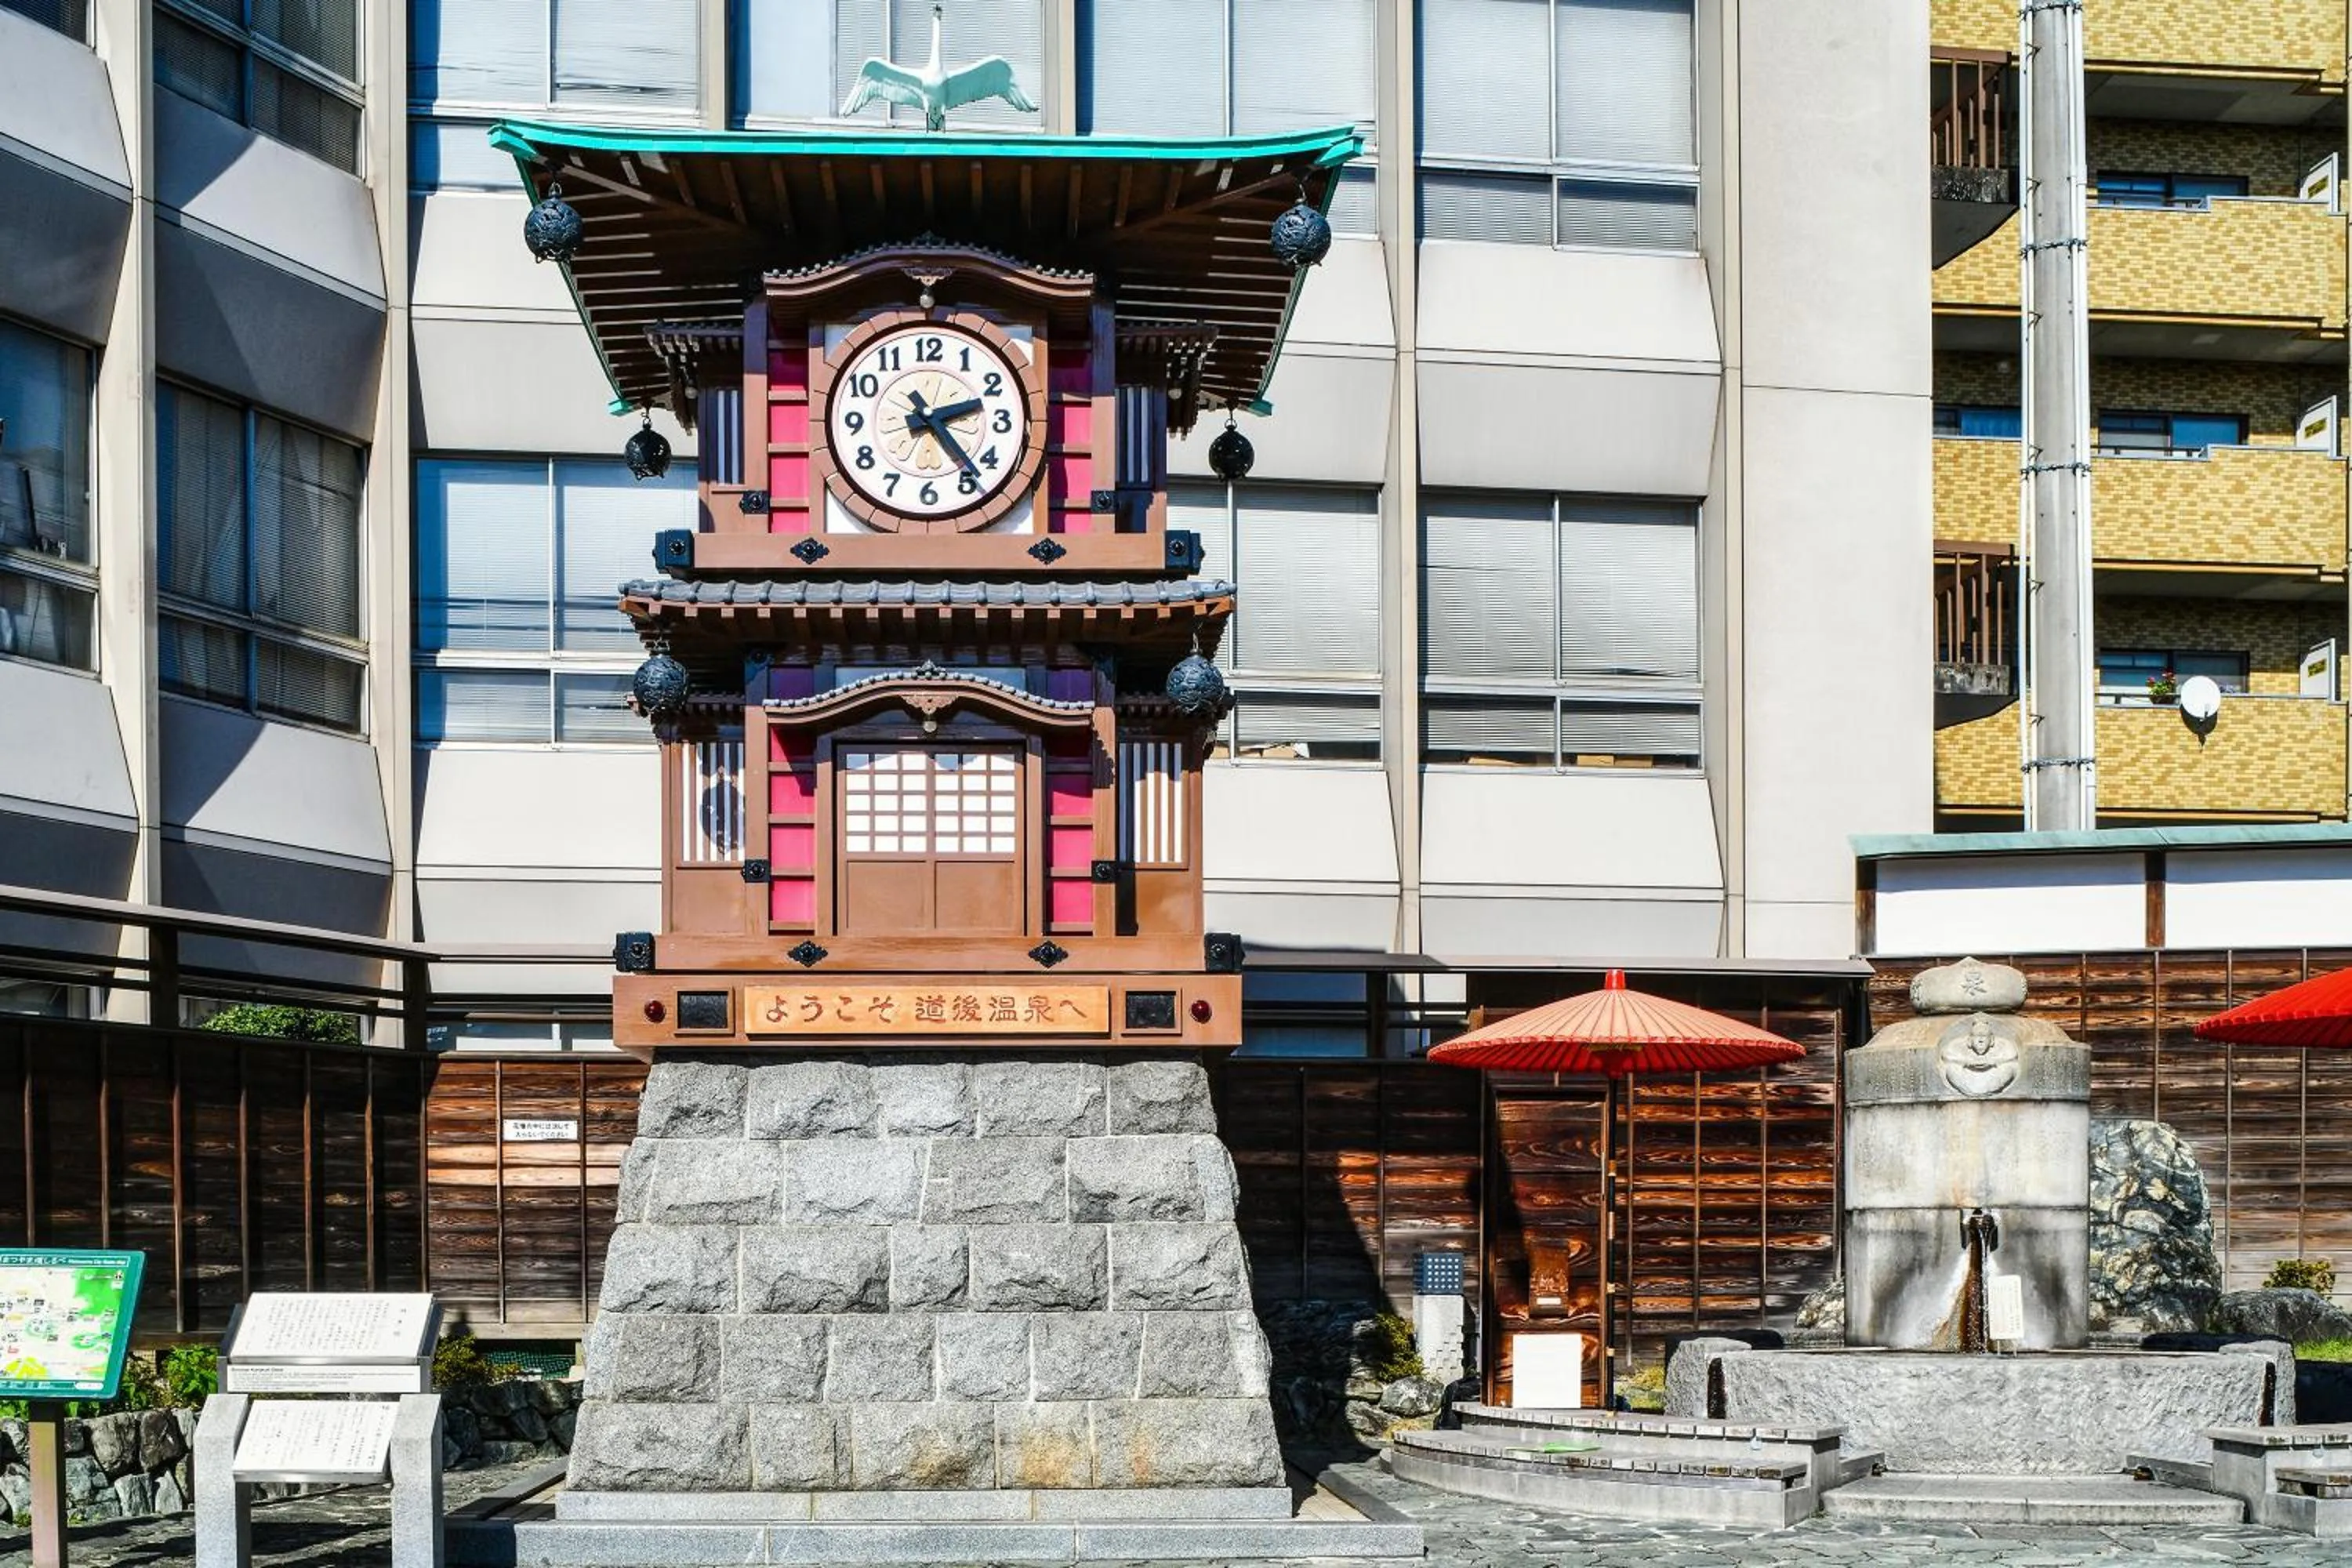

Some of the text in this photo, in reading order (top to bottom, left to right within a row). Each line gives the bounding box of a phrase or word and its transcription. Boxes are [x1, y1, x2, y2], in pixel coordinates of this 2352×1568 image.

[878, 347, 901, 371] 11
[916, 338, 943, 363] 12
[960, 347, 971, 372] 1
[850, 373, 879, 397] 10
[984, 372, 1003, 397] 2
[844, 412, 865, 436] 9
[993, 409, 1012, 434] 3
[856, 446, 876, 470] 8
[980, 446, 999, 470] 4
[883, 473, 901, 497] 7
[920, 481, 938, 506] 6
[957, 471, 978, 495] 5
[766, 995, 1087, 1024] ようこそ 道後温泉へ
